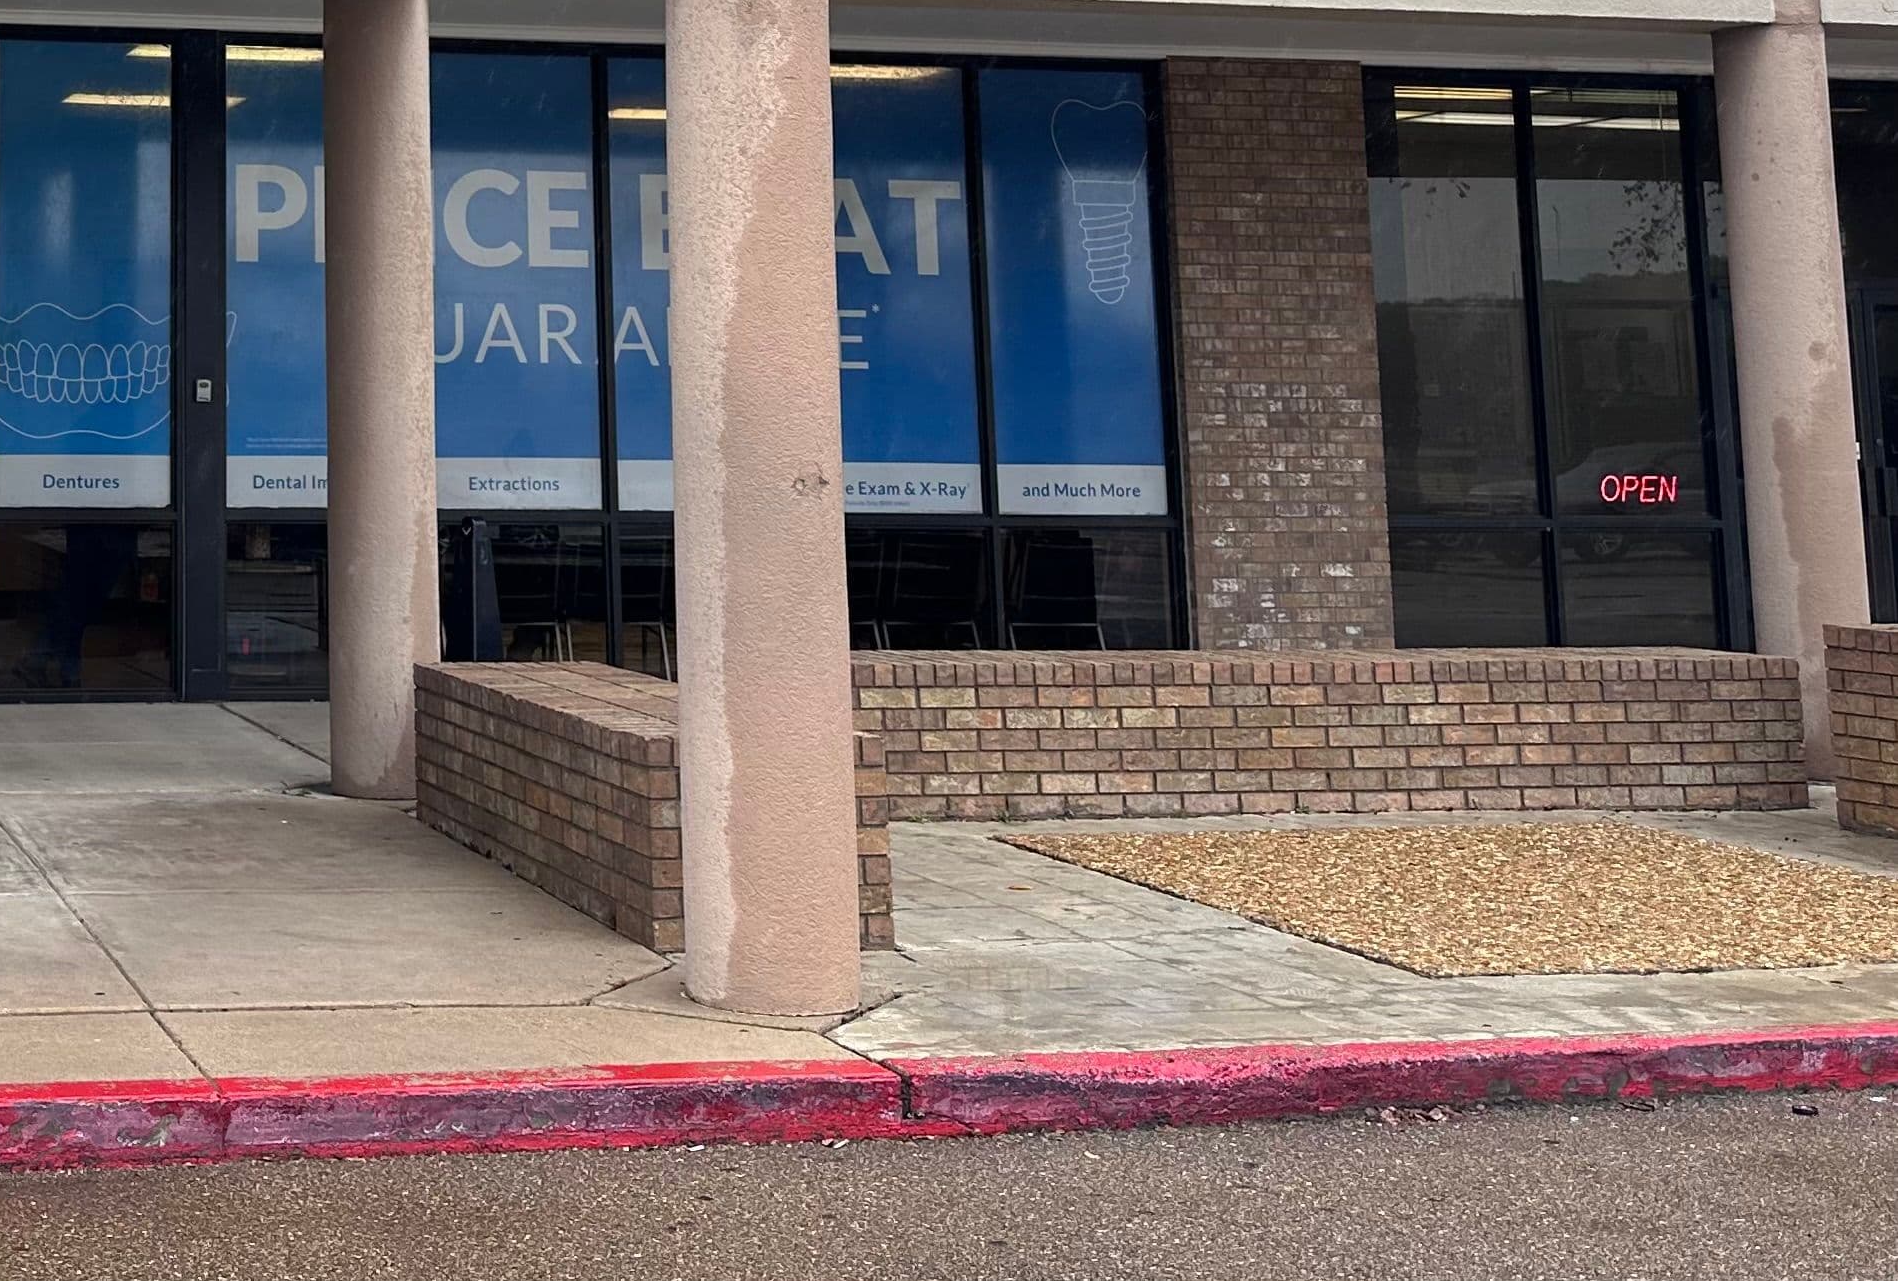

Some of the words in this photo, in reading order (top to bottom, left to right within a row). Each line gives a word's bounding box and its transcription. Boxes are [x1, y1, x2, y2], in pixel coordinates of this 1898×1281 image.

[236, 164, 590, 269] PCE
[42, 473, 120, 490] Dentures
[253, 473, 307, 490] Dental
[468, 474, 561, 493] Extractions
[858, 481, 900, 496] Exam
[904, 481, 916, 496] &
[1022, 482, 1050, 498] and
[1053, 482, 1097, 498] Much
[1101, 482, 1142, 498] More
[1601, 474, 1679, 504] OPEN
